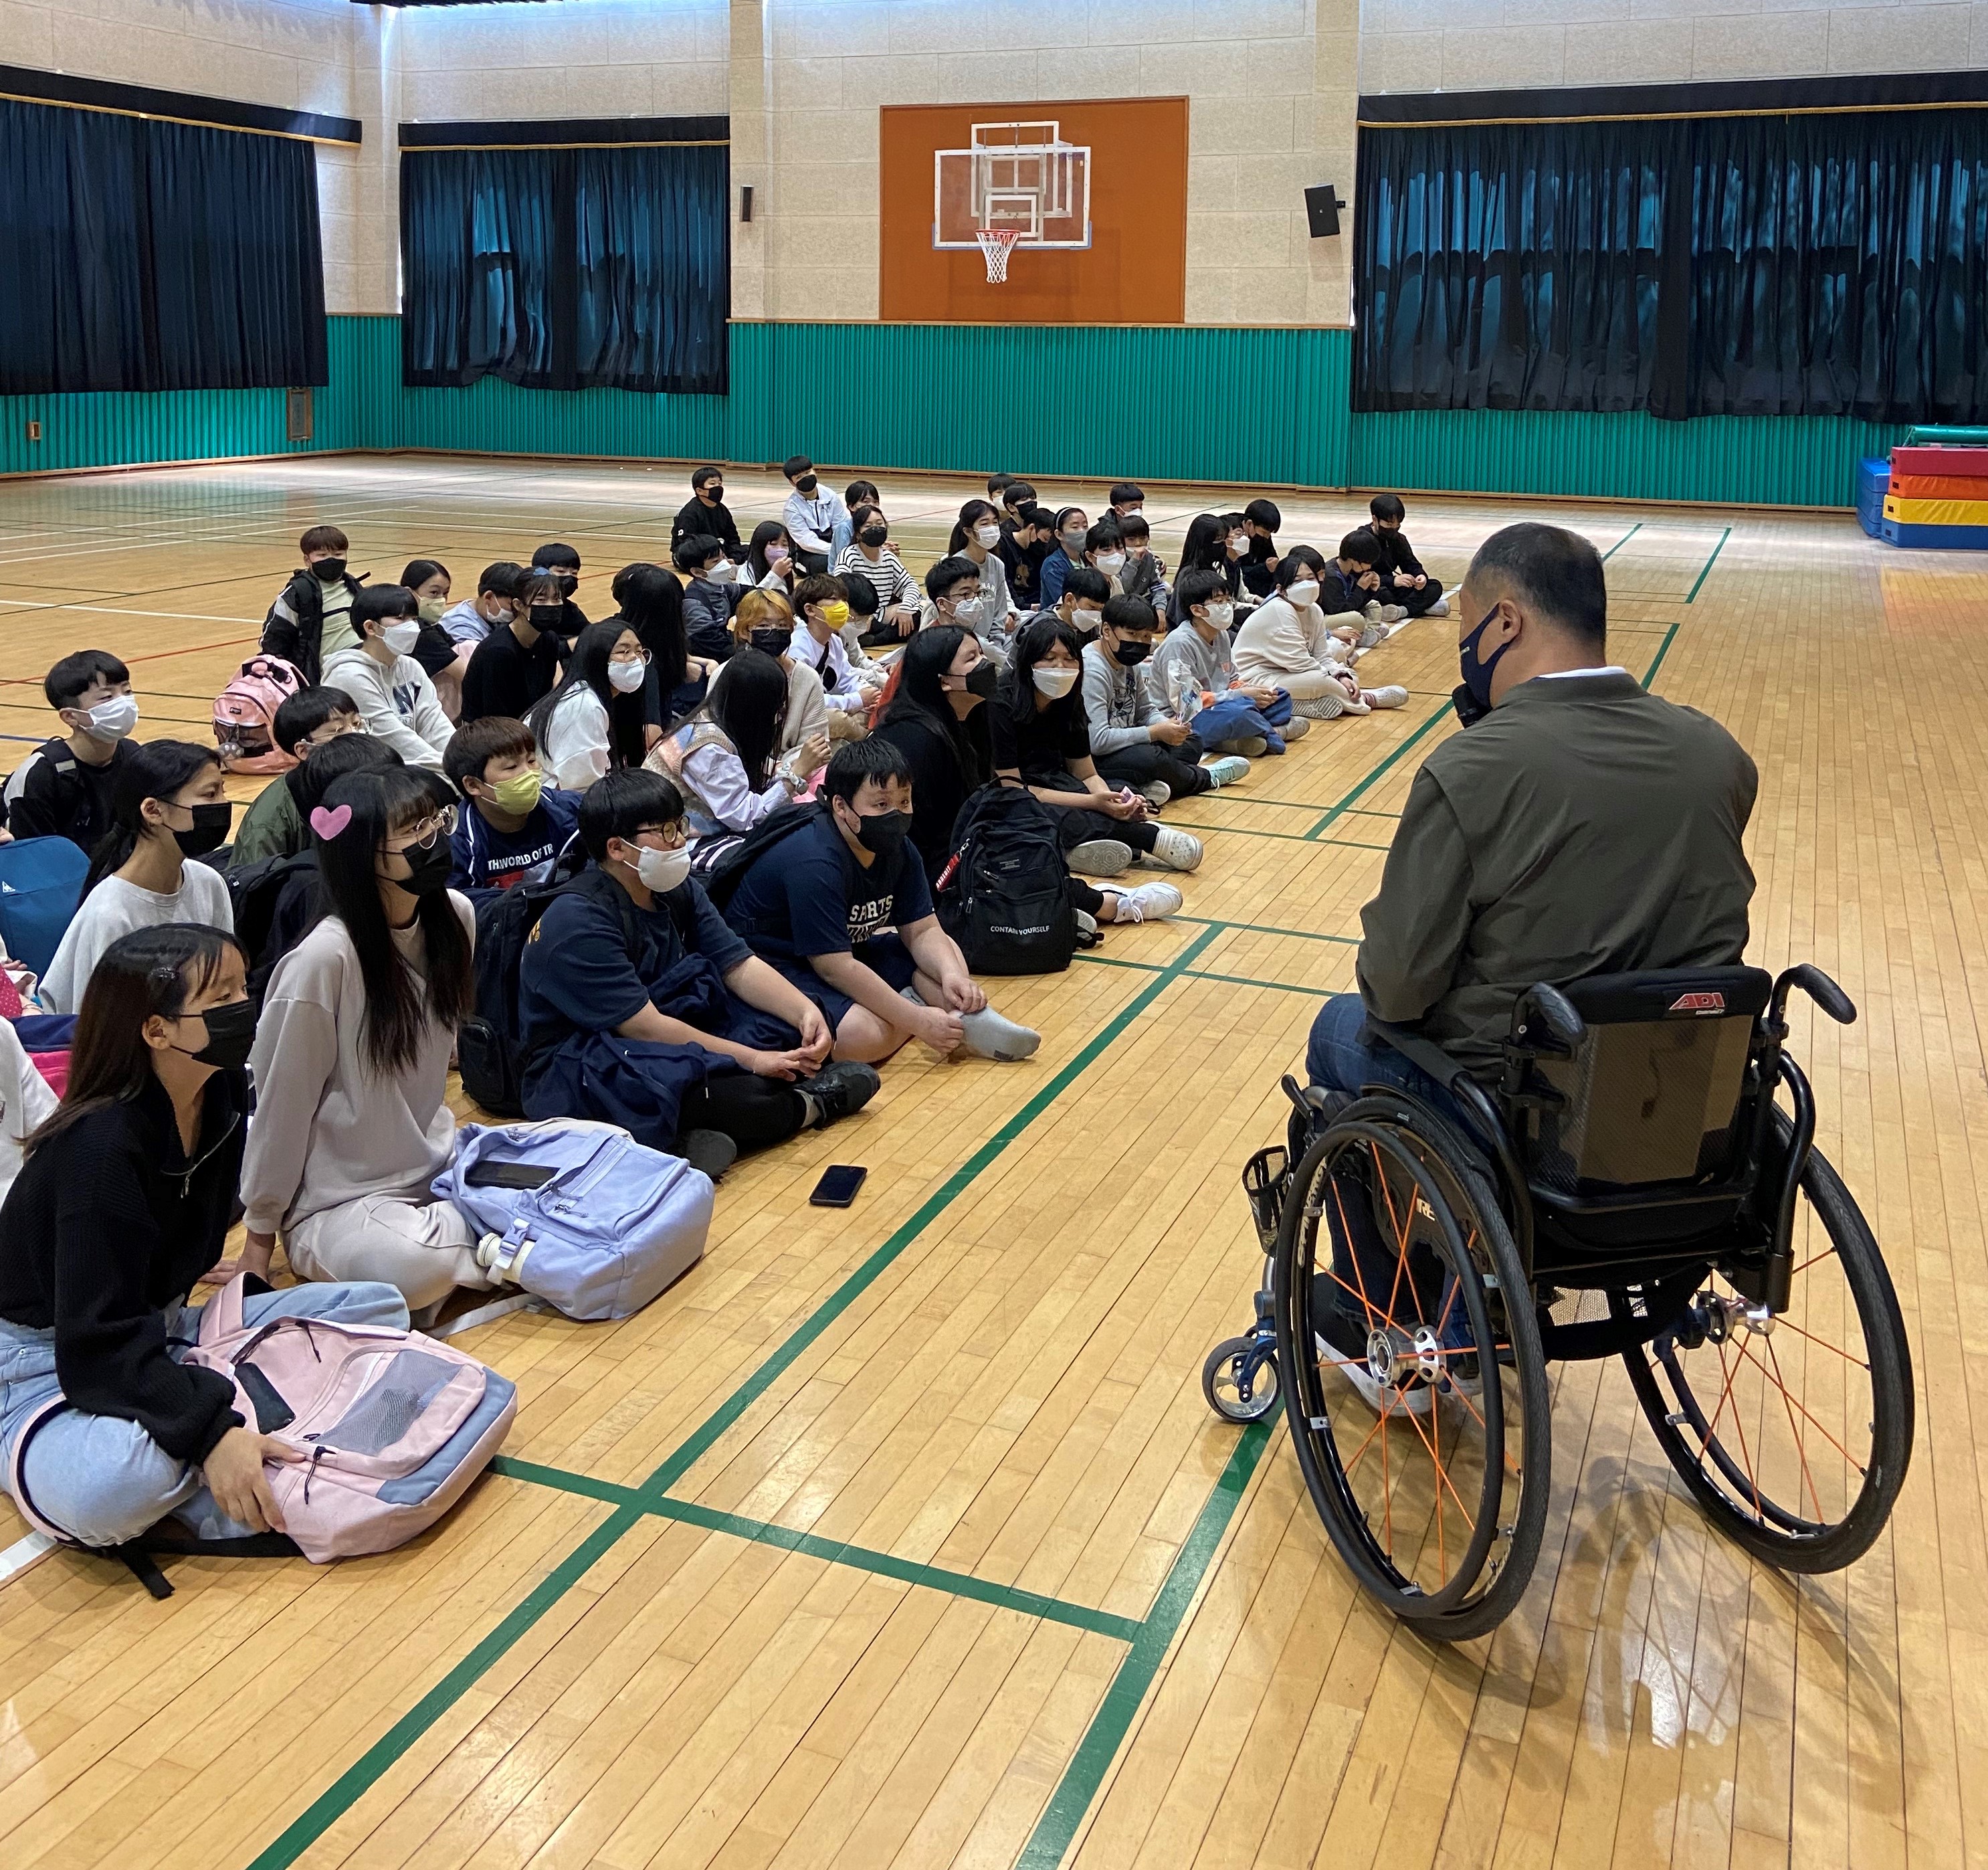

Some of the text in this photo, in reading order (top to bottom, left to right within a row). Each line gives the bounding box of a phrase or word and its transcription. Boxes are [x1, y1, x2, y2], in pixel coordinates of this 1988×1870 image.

[488, 859, 500, 870] TH
[499, 854, 531, 869] WORLD
[542, 843, 554, 856] TR
[1019, 925, 1050, 935] YOURSELF
[1669, 992, 1725, 1010] ADI
